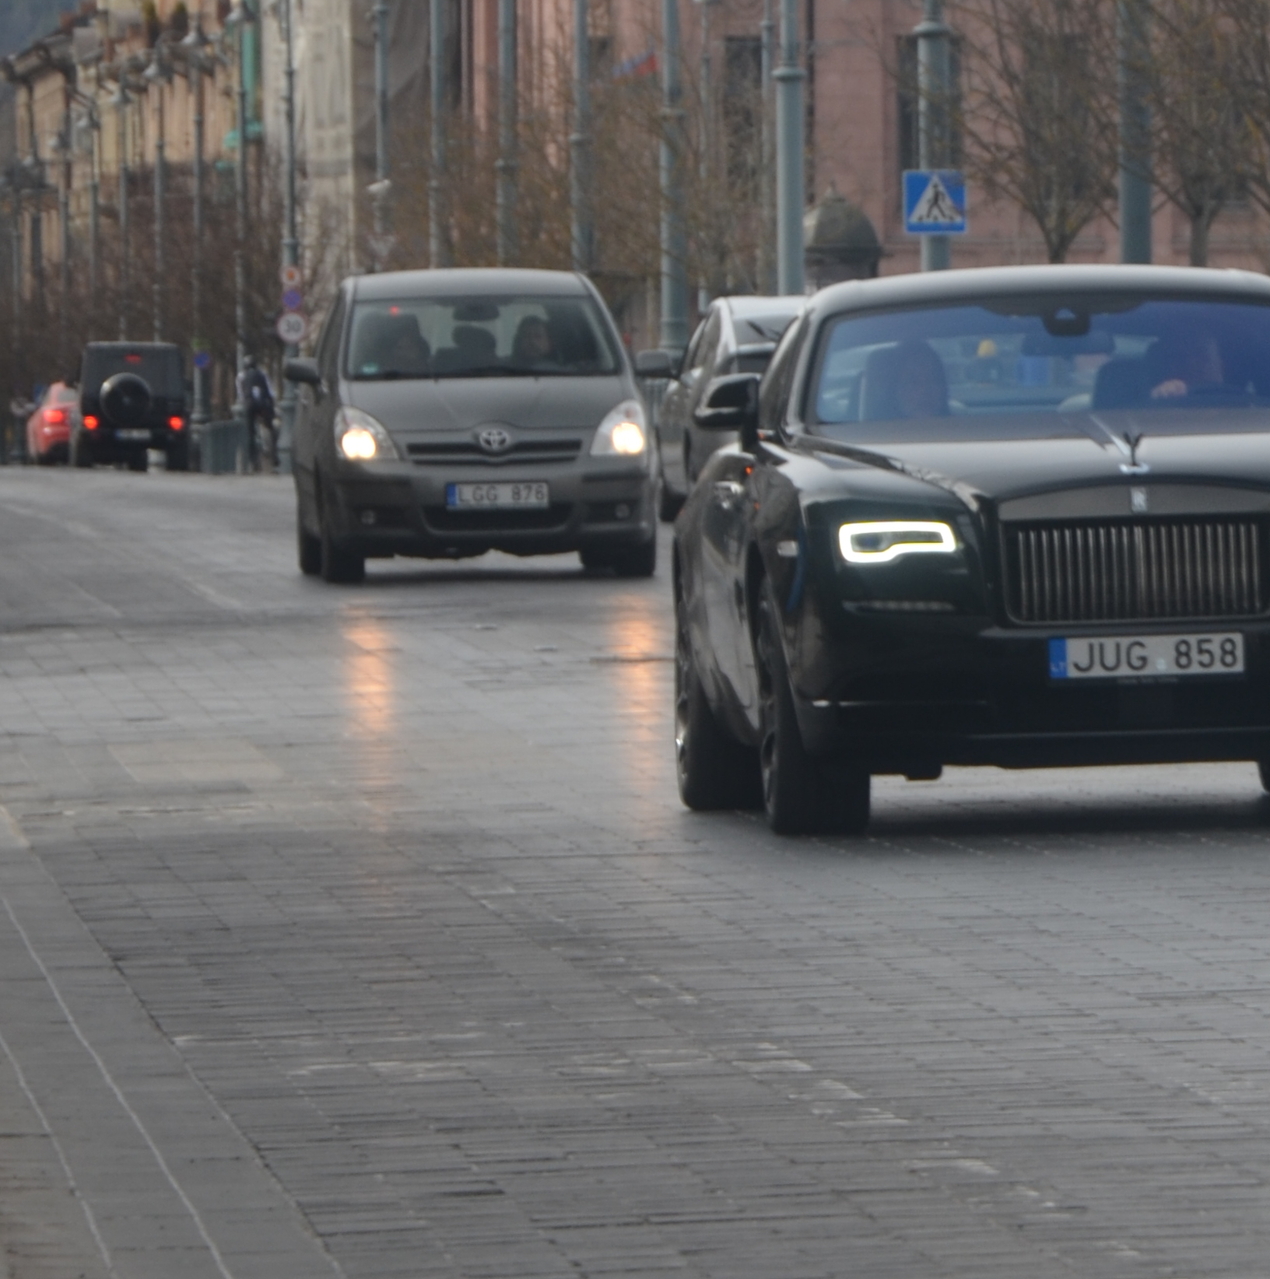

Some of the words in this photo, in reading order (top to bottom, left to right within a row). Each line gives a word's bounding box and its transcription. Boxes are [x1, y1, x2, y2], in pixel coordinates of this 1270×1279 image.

[458, 485, 498, 502] LGG
[511, 485, 545, 501] 876
[1073, 641, 1149, 673] JUG
[1174, 638, 1238, 669] 858
